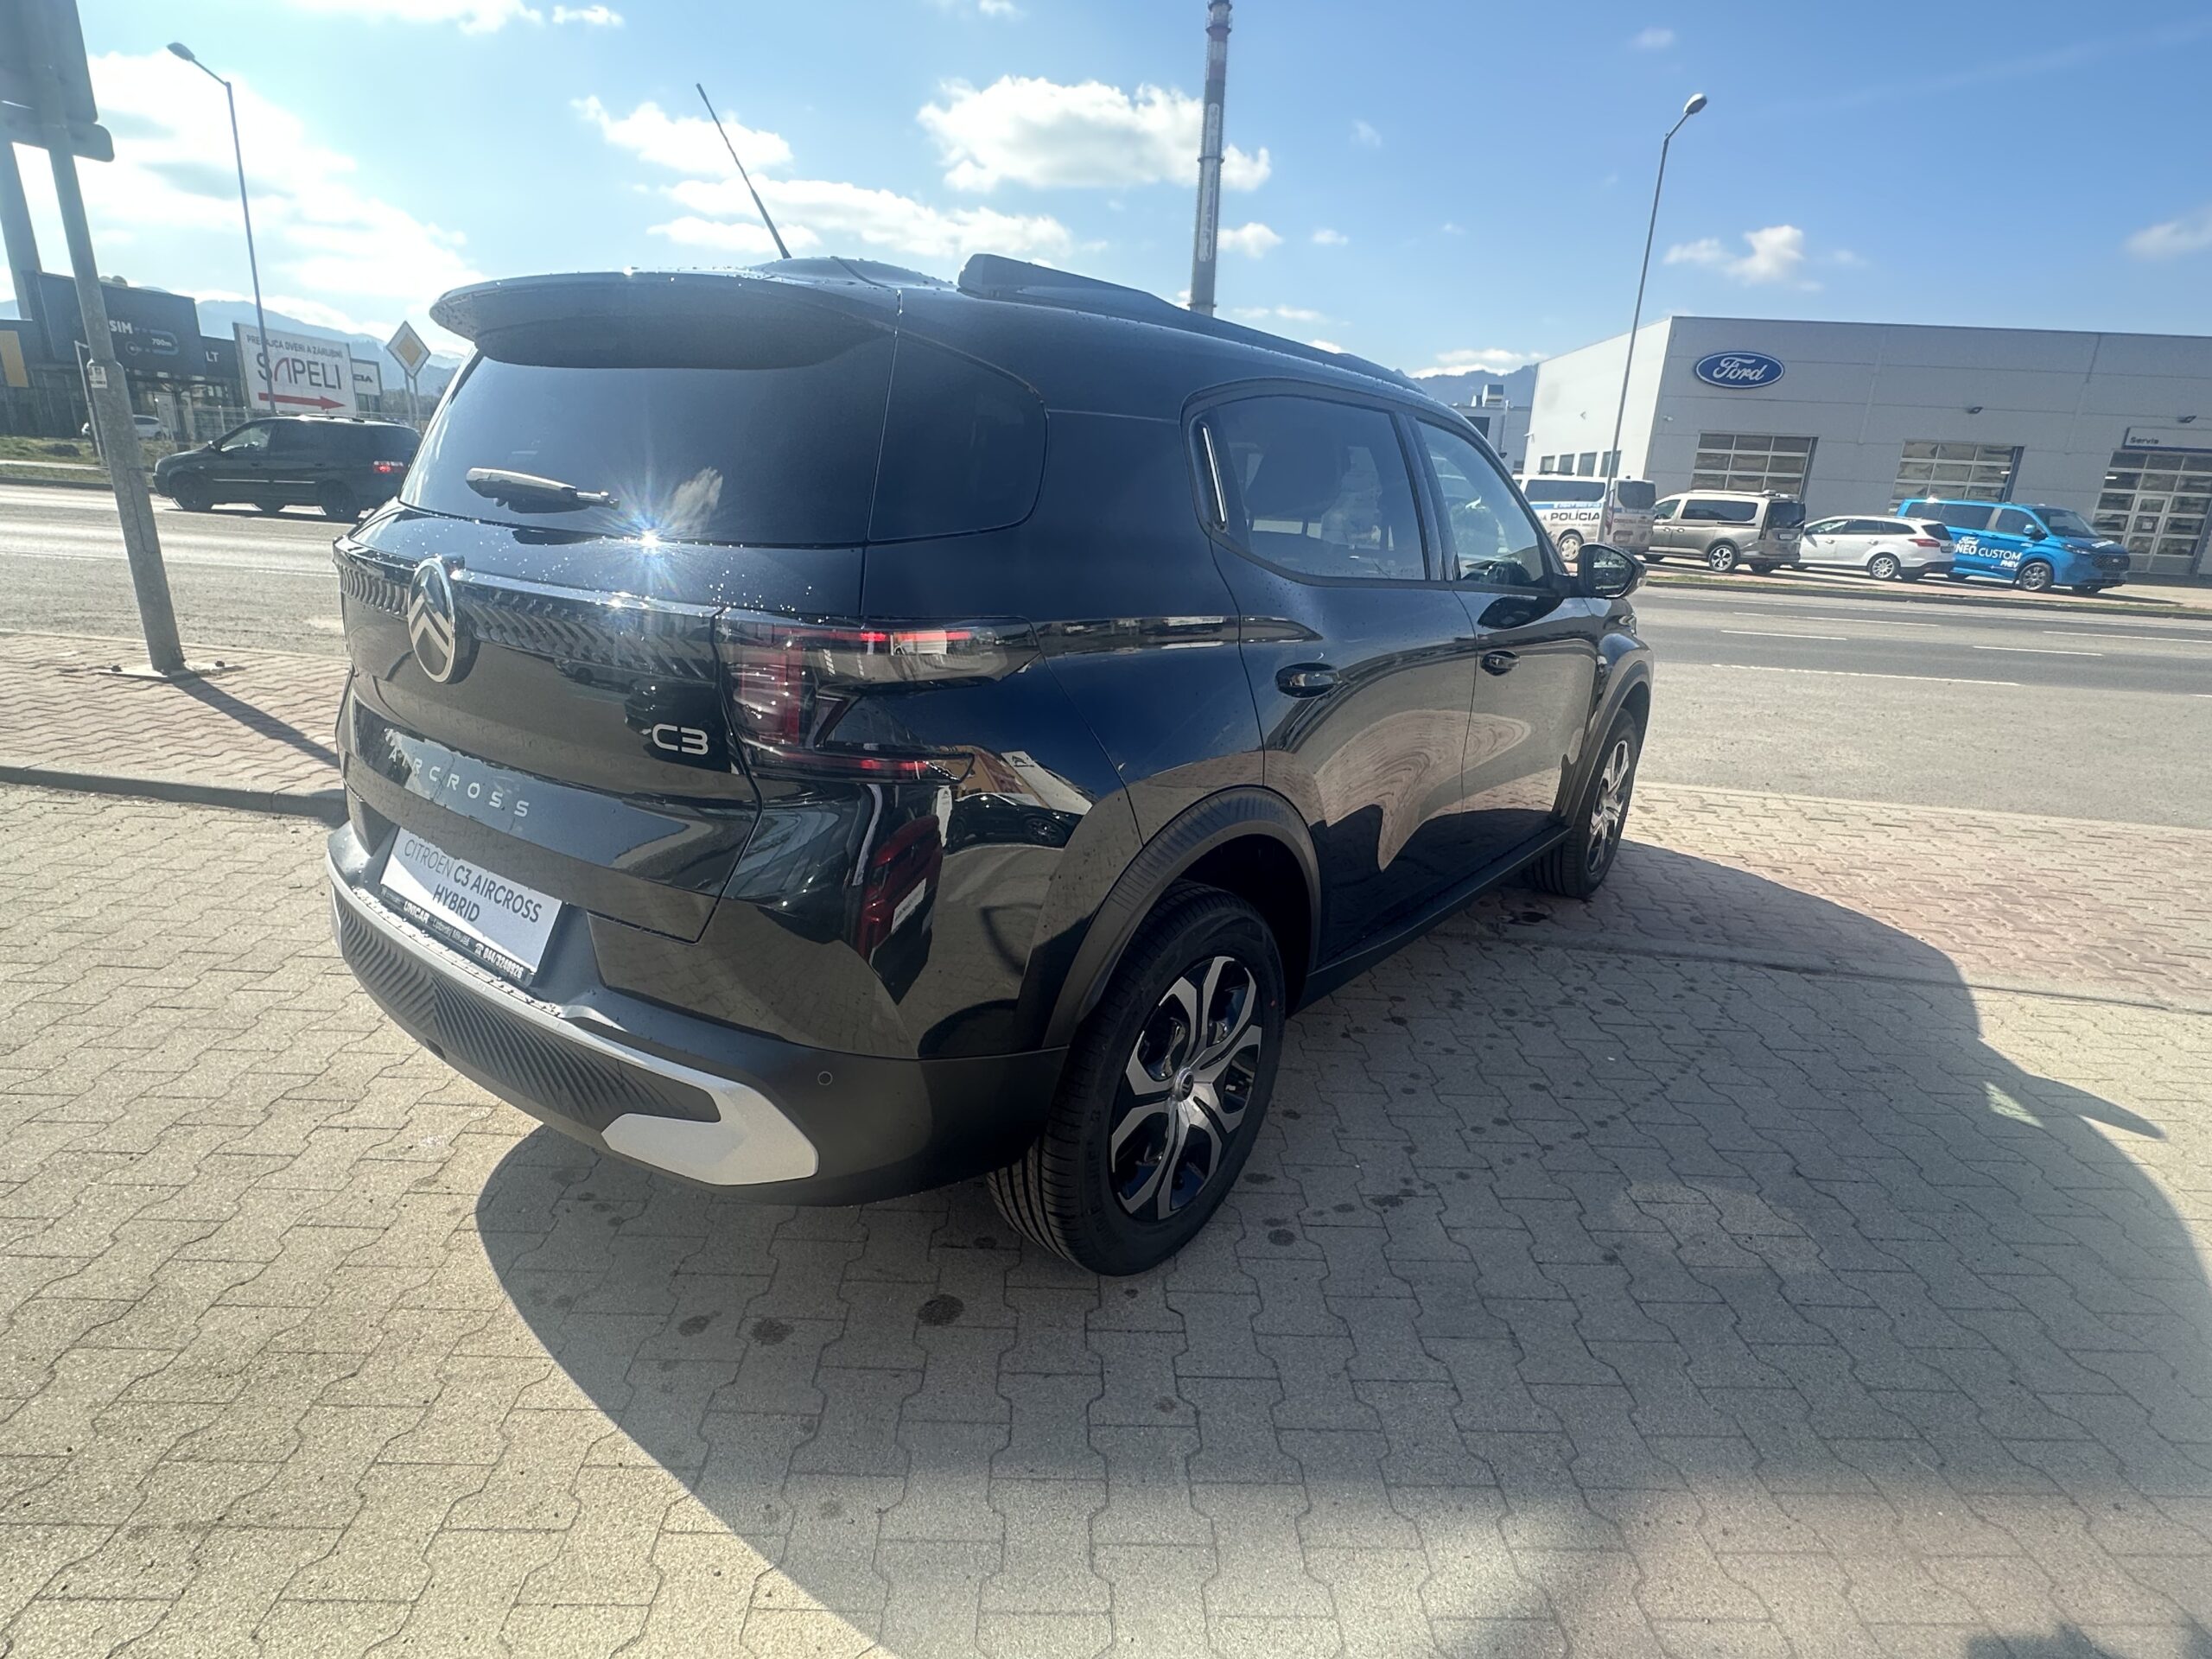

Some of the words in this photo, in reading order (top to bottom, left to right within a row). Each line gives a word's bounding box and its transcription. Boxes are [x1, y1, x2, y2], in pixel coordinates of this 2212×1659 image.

[246, 334, 284, 351] PREAJCA
[257, 353, 341, 390] SAPELI
[1713, 356, 1768, 381] Ford
[2130, 436, 2159, 445] Servis
[1550, 509, 1600, 521] POLÍCIA
[1955, 543, 1977, 555] NEO
[1978, 547, 2022, 561] CUSTOM
[652, 723, 709, 755] C3
[389, 747, 530, 817] AIRCROSS
[404, 839, 455, 878] CITROEN
[454, 865, 472, 887] C3
[471, 874, 543, 924] AIRCROSS
[433, 884, 480, 922] HYBRID
